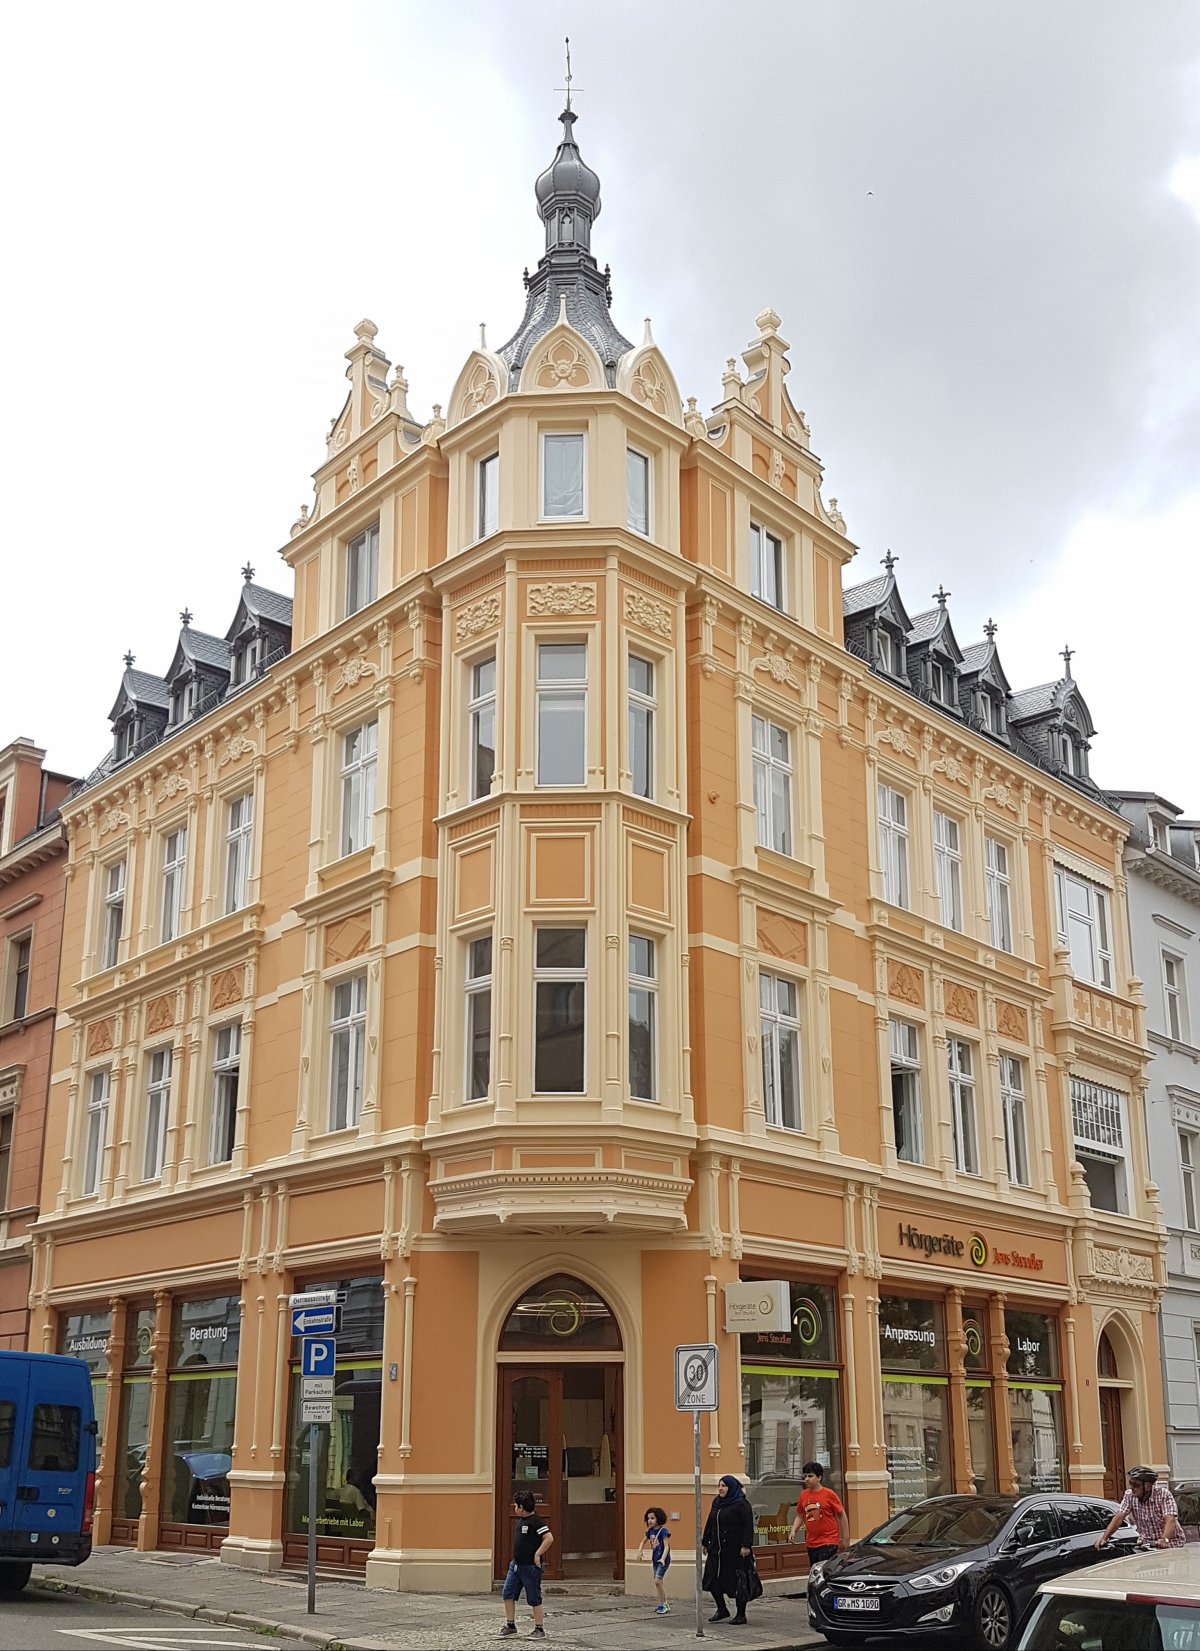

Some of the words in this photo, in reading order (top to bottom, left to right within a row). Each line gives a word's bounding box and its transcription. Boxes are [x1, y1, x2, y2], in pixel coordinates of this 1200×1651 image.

[899, 1222, 965, 1258] Hörgeräte
[303, 1316, 332, 1325] Einbahnstraße
[190, 1326, 228, 1342] Beratung
[757, 1331, 769, 1343] Jens
[884, 1324, 936, 1347] Anpassung
[69, 1337, 108, 1353] Ausbildung
[1017, 1337, 1040, 1352] Labor
[310, 1343, 328, 1372] P
[688, 1364, 703, 1382] 30
[686, 1394, 706, 1404] ZONE
[349, 1518, 364, 1527] Labor
[838, 1598, 847, 1608] GR
[850, 1598, 860, 1608] MS
[861, 1599, 879, 1609] 1090
